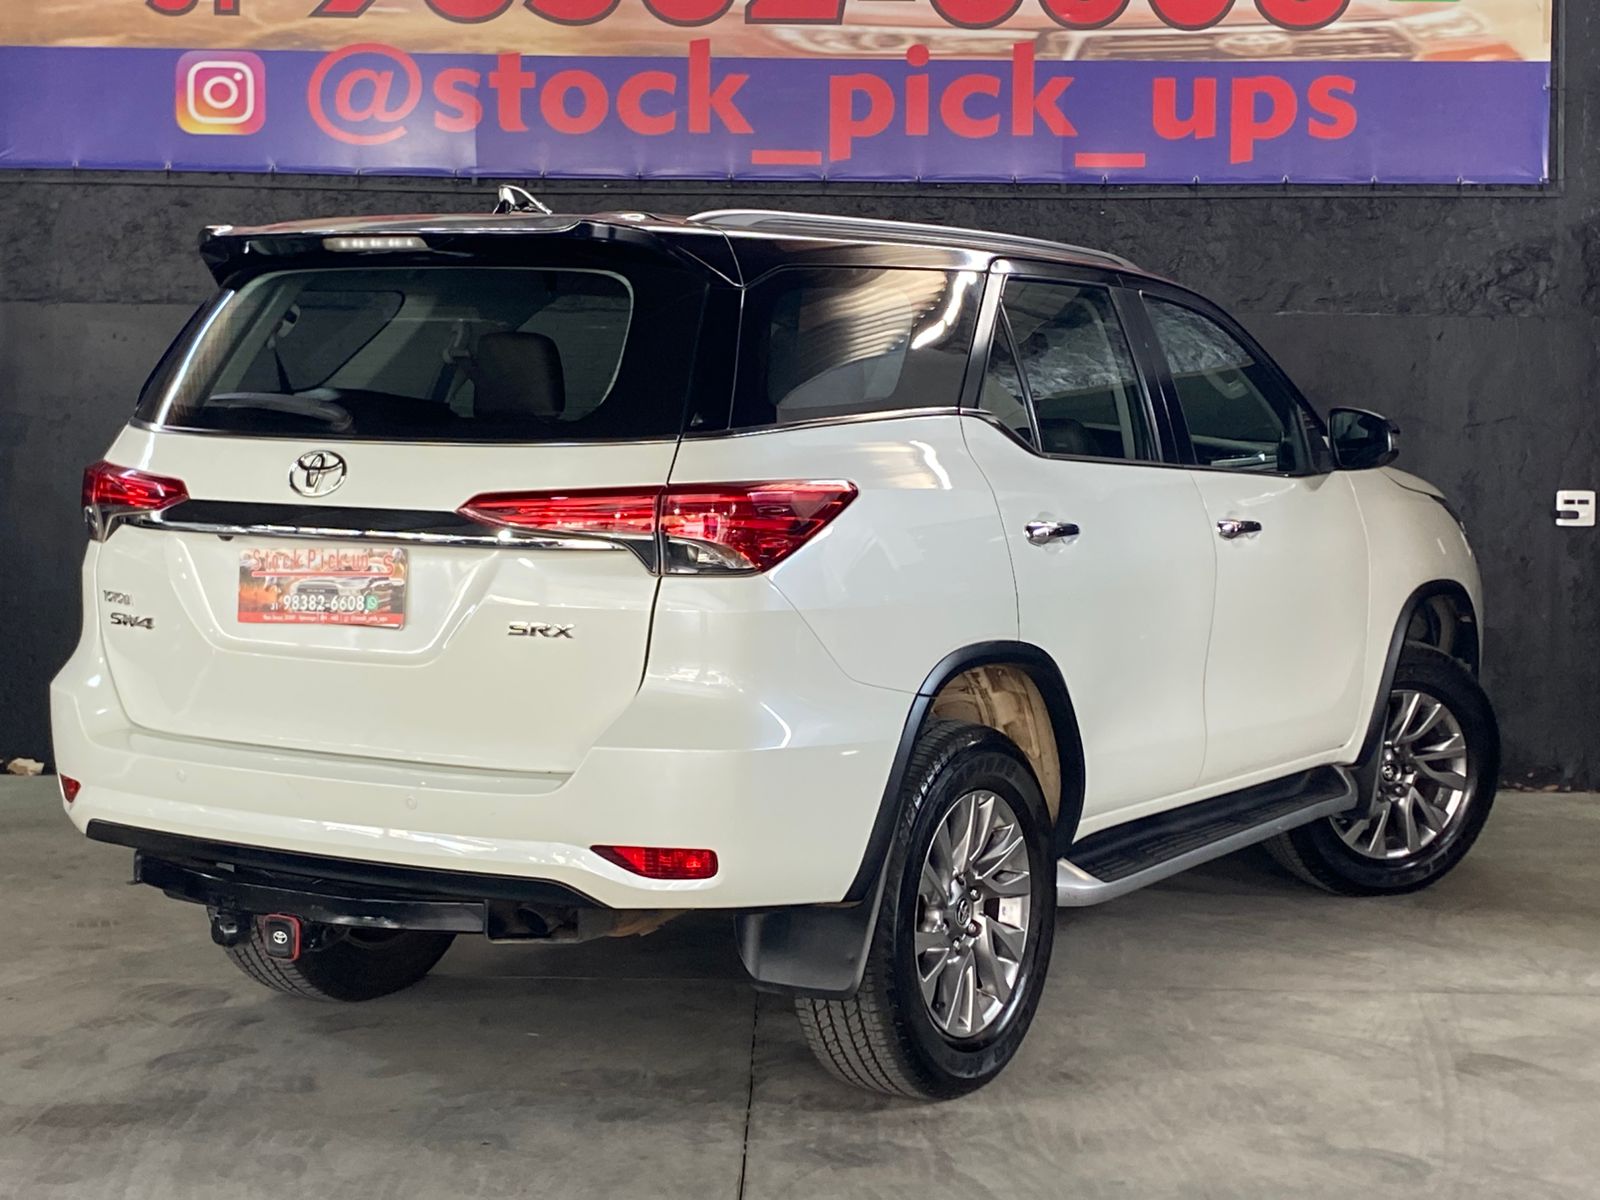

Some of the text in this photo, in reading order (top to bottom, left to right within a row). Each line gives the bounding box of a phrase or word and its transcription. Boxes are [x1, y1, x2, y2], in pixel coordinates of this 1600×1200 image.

[308, 38, 1358, 167] @stock_pick_ups
[283, 594, 365, 612] 98382-6608
[110, 612, 155, 630] SW4
[508, 621, 575, 639] SRX
